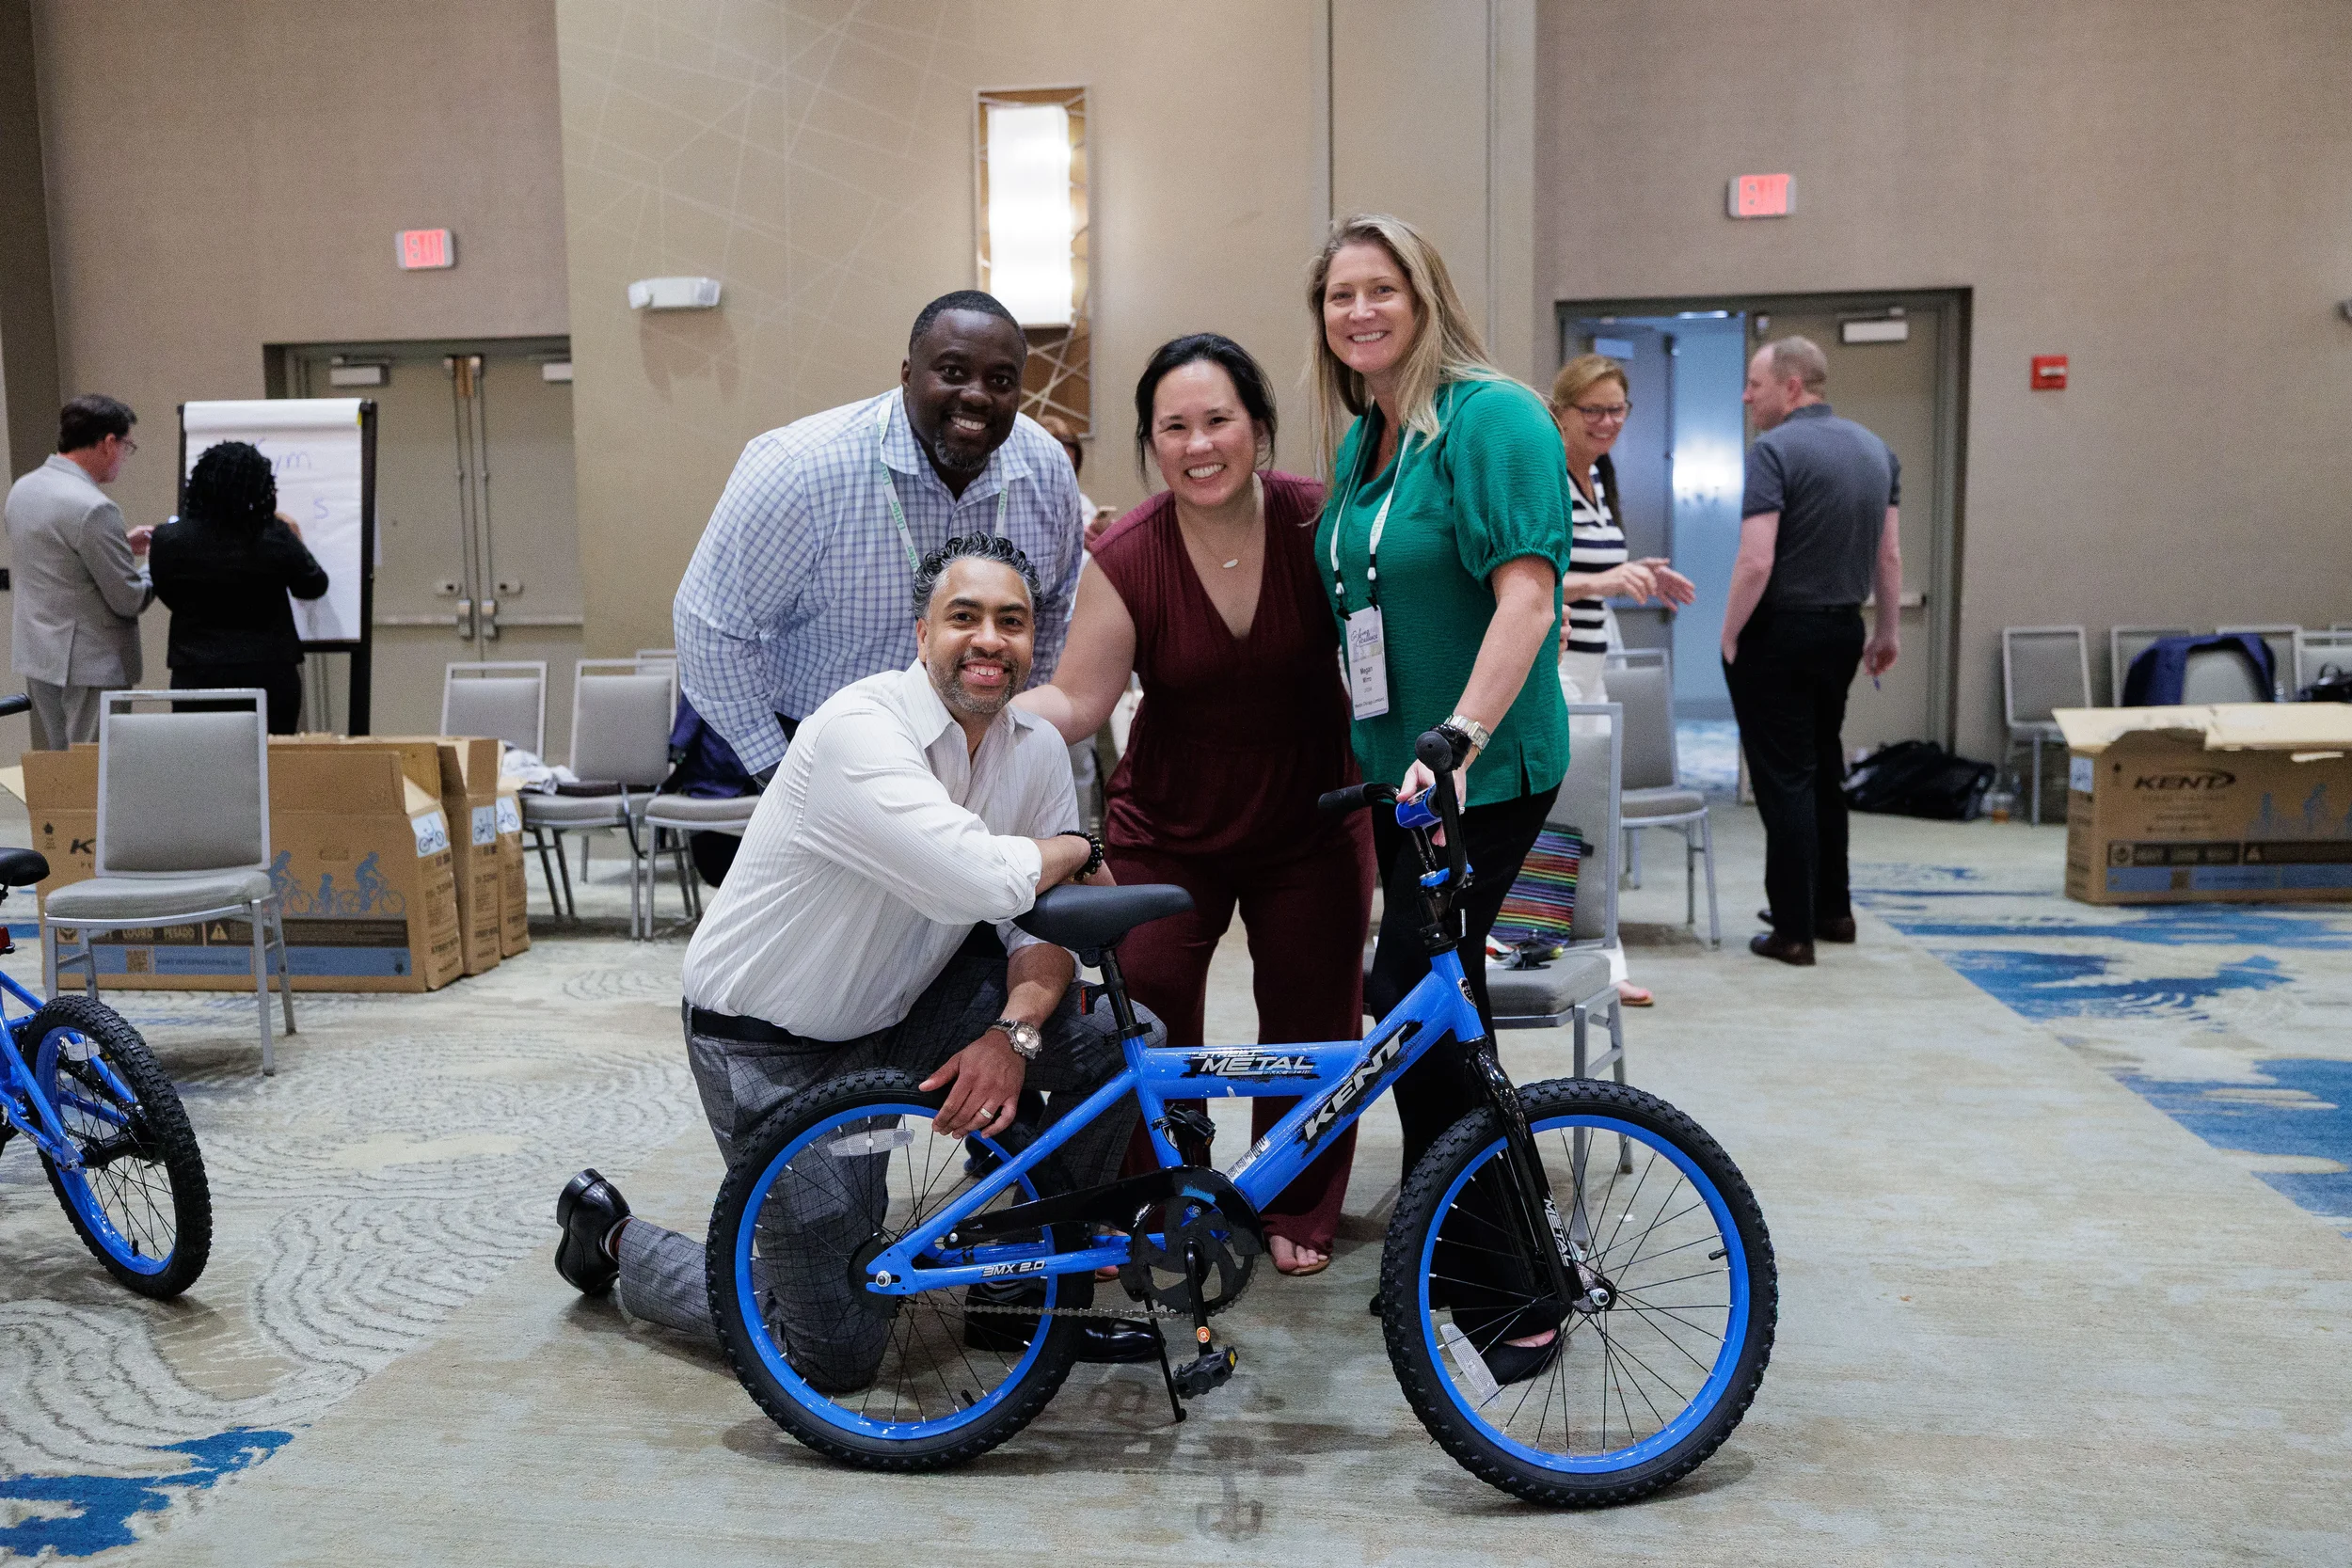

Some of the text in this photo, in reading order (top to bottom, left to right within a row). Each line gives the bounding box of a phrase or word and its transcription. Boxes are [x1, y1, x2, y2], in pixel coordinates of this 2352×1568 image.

[1359, 666, 1374, 675] Megan
[2134, 775, 2222, 790] KENT
[1200, 1055, 1314, 1076] METAL
[1305, 1024, 1407, 1141] KENT
[1544, 1198, 1572, 1267] METAL
[1019, 1260, 1045, 1273] 2.0
